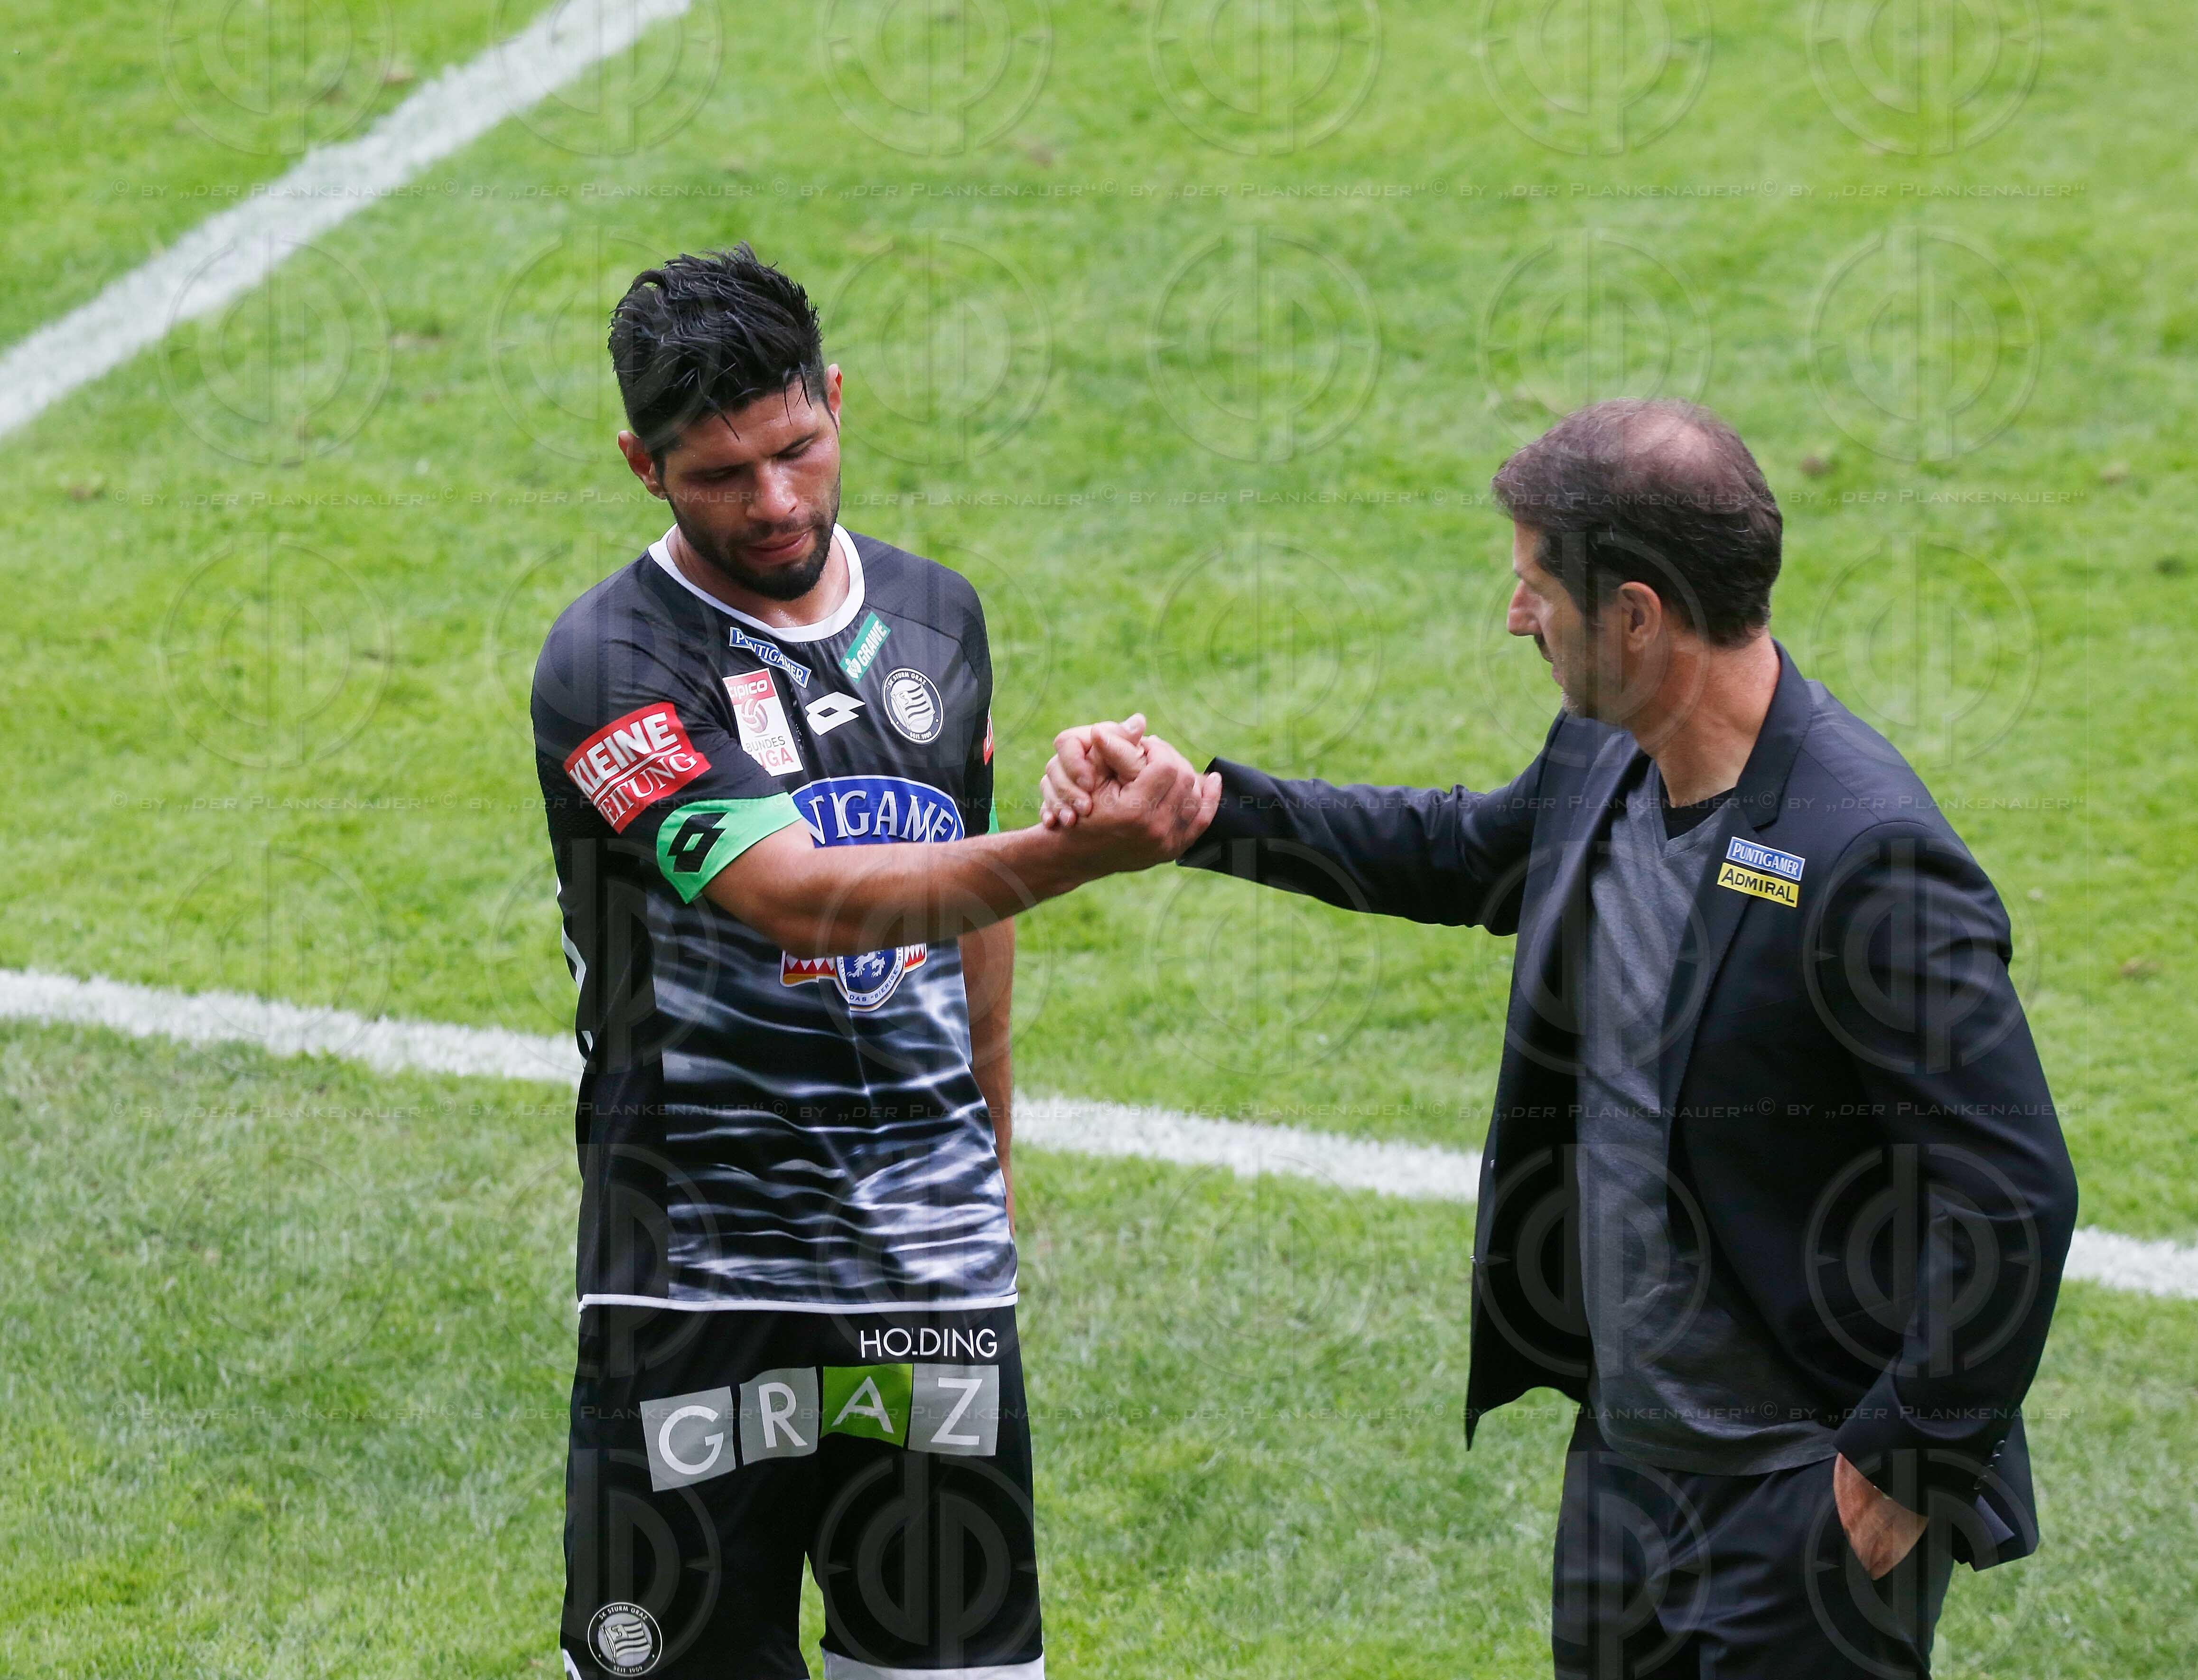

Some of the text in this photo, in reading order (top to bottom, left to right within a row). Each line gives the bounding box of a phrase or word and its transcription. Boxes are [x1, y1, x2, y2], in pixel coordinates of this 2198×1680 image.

[857, 619, 887, 667] GRAWE
[893, 672, 910, 681] STURM
[911, 673, 927, 686] GRAZ
[745, 735, 786, 753] BUNDES
[910, 731, 920, 739] SEIT
[569, 712, 678, 799] KLEINE
[758, 747, 794, 769] IGA
[597, 752, 698, 827] EITUNG
[1732, 842, 1799, 876] PUNTIGAMER
[1720, 868, 1795, 904] ADMIRAL
[860, 1327, 997, 1359] HODING
[658, 1375, 982, 1475] GRAZ
[599, 1605, 648, 1621] SK STURM GRAZ
